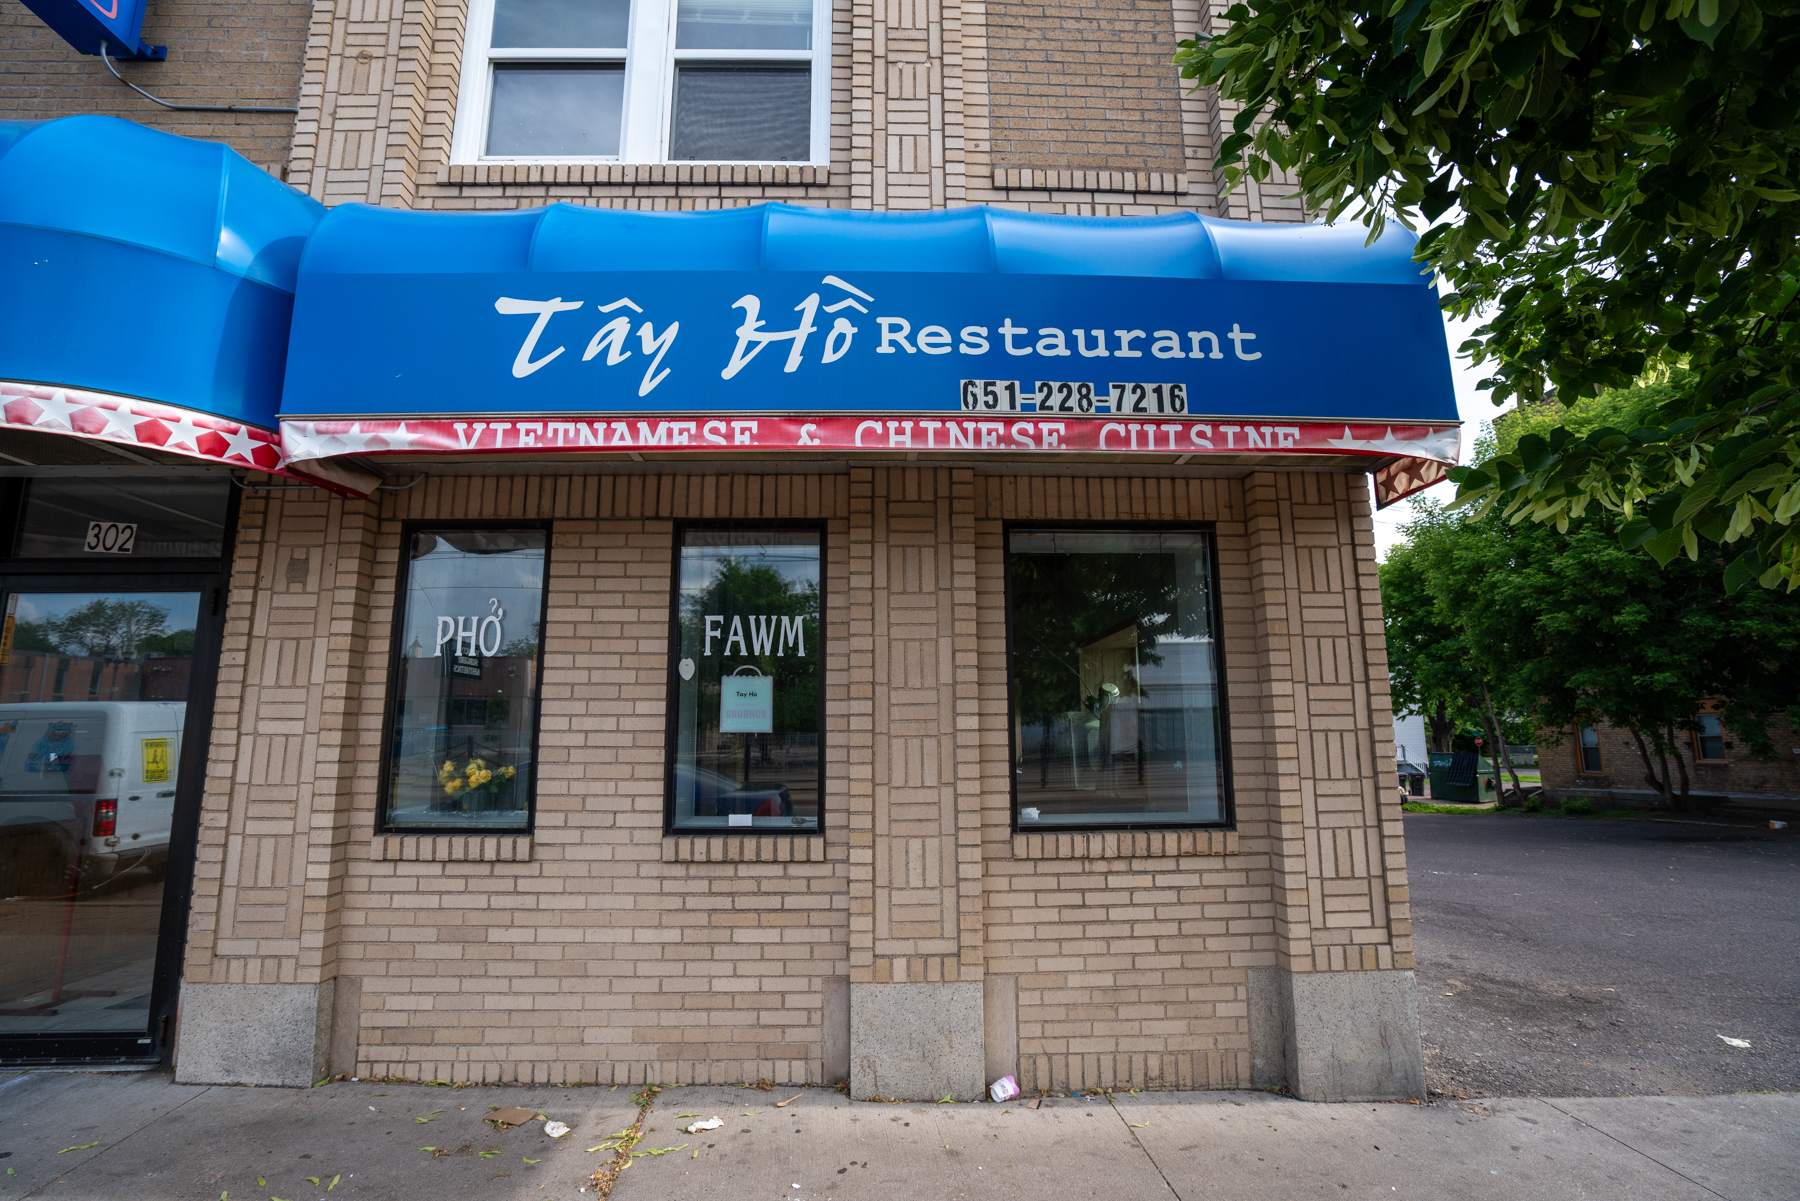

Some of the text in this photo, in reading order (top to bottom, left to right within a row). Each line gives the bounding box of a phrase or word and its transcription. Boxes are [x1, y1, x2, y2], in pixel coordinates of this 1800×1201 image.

[495, 275, 1262, 397] Tây Hồ Restaurant
[962, 380, 1185, 413] 651-228-7216
[453, 421, 759, 449] VIETNAMESE
[797, 423, 821, 446] &
[855, 420, 1067, 450] CHINESE
[87, 523, 135, 553] 302
[434, 598, 504, 657] PHỞ
[703, 615, 806, 657] FAWM
[725, 709, 767, 719] GRUBHUB
